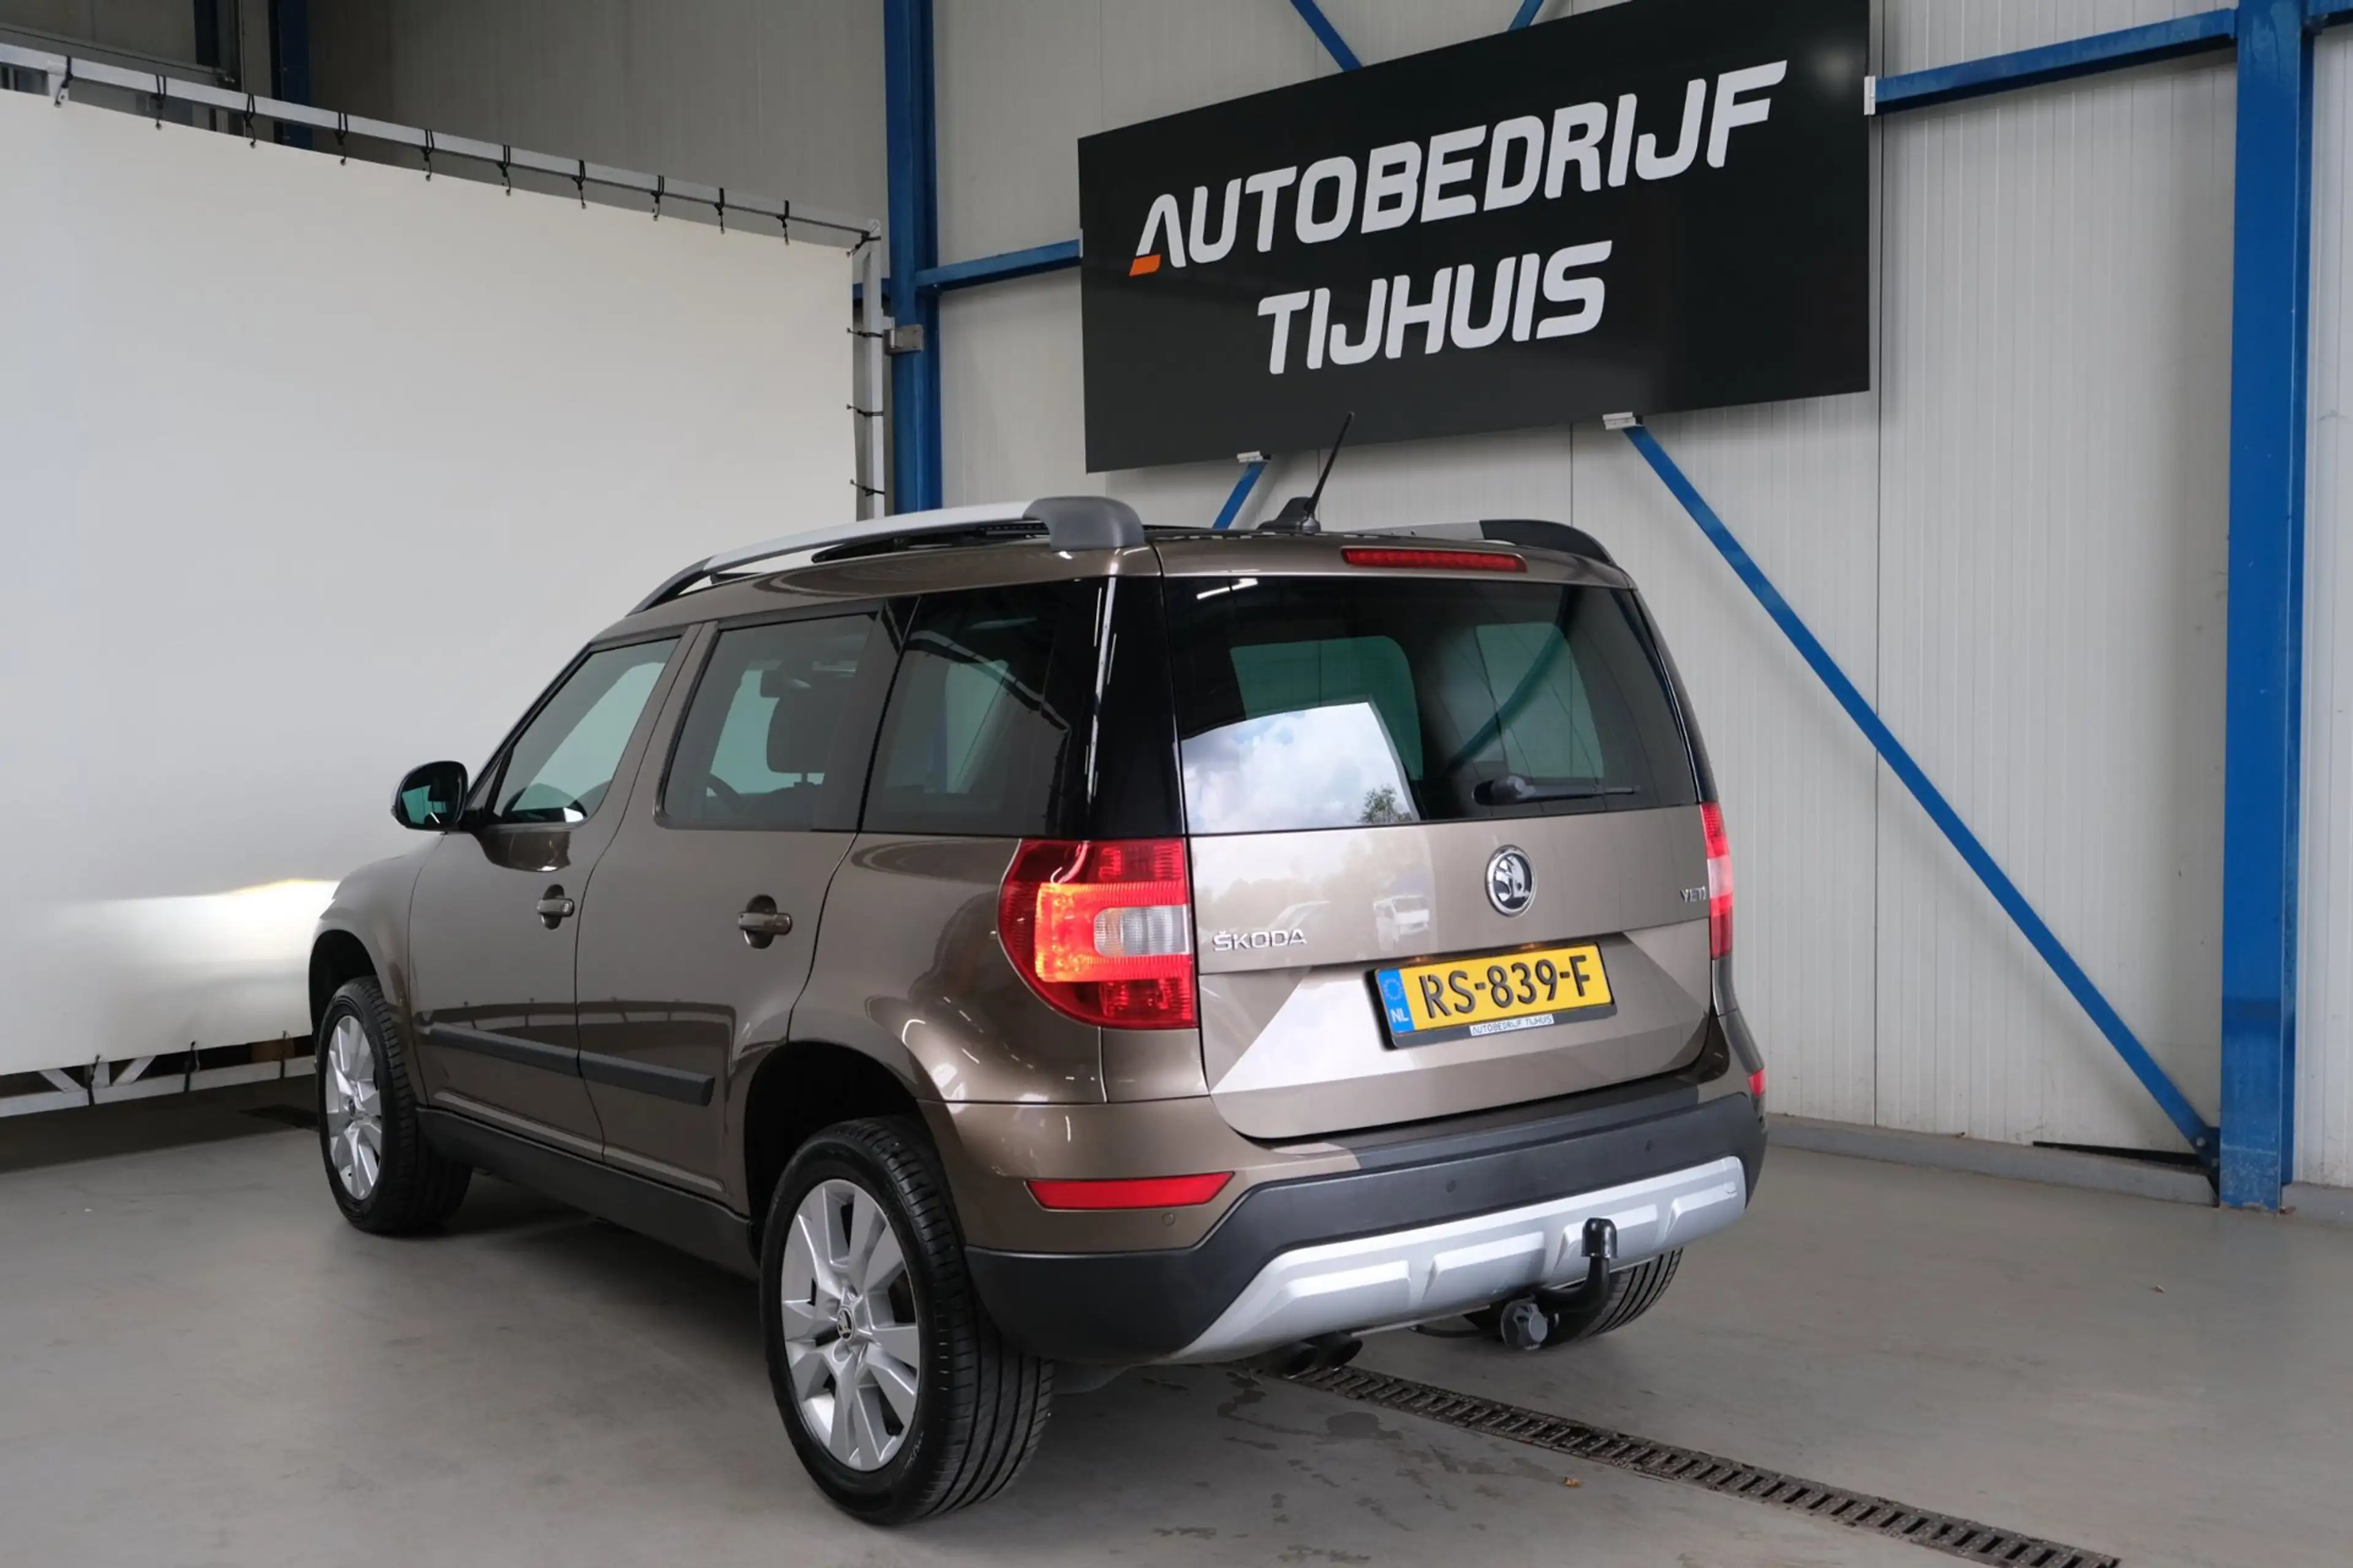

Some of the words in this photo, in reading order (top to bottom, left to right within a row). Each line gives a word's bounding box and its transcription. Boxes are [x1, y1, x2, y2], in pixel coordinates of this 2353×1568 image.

[1129, 59, 1788, 276] AUTOBEDRIJF
[1257, 240, 1612, 375] TIJHUIS
[1213, 928, 1307, 951] ŠKODA
[1390, 1007, 1409, 1023] NL
[1419, 955, 1591, 1018] RS-839-F
